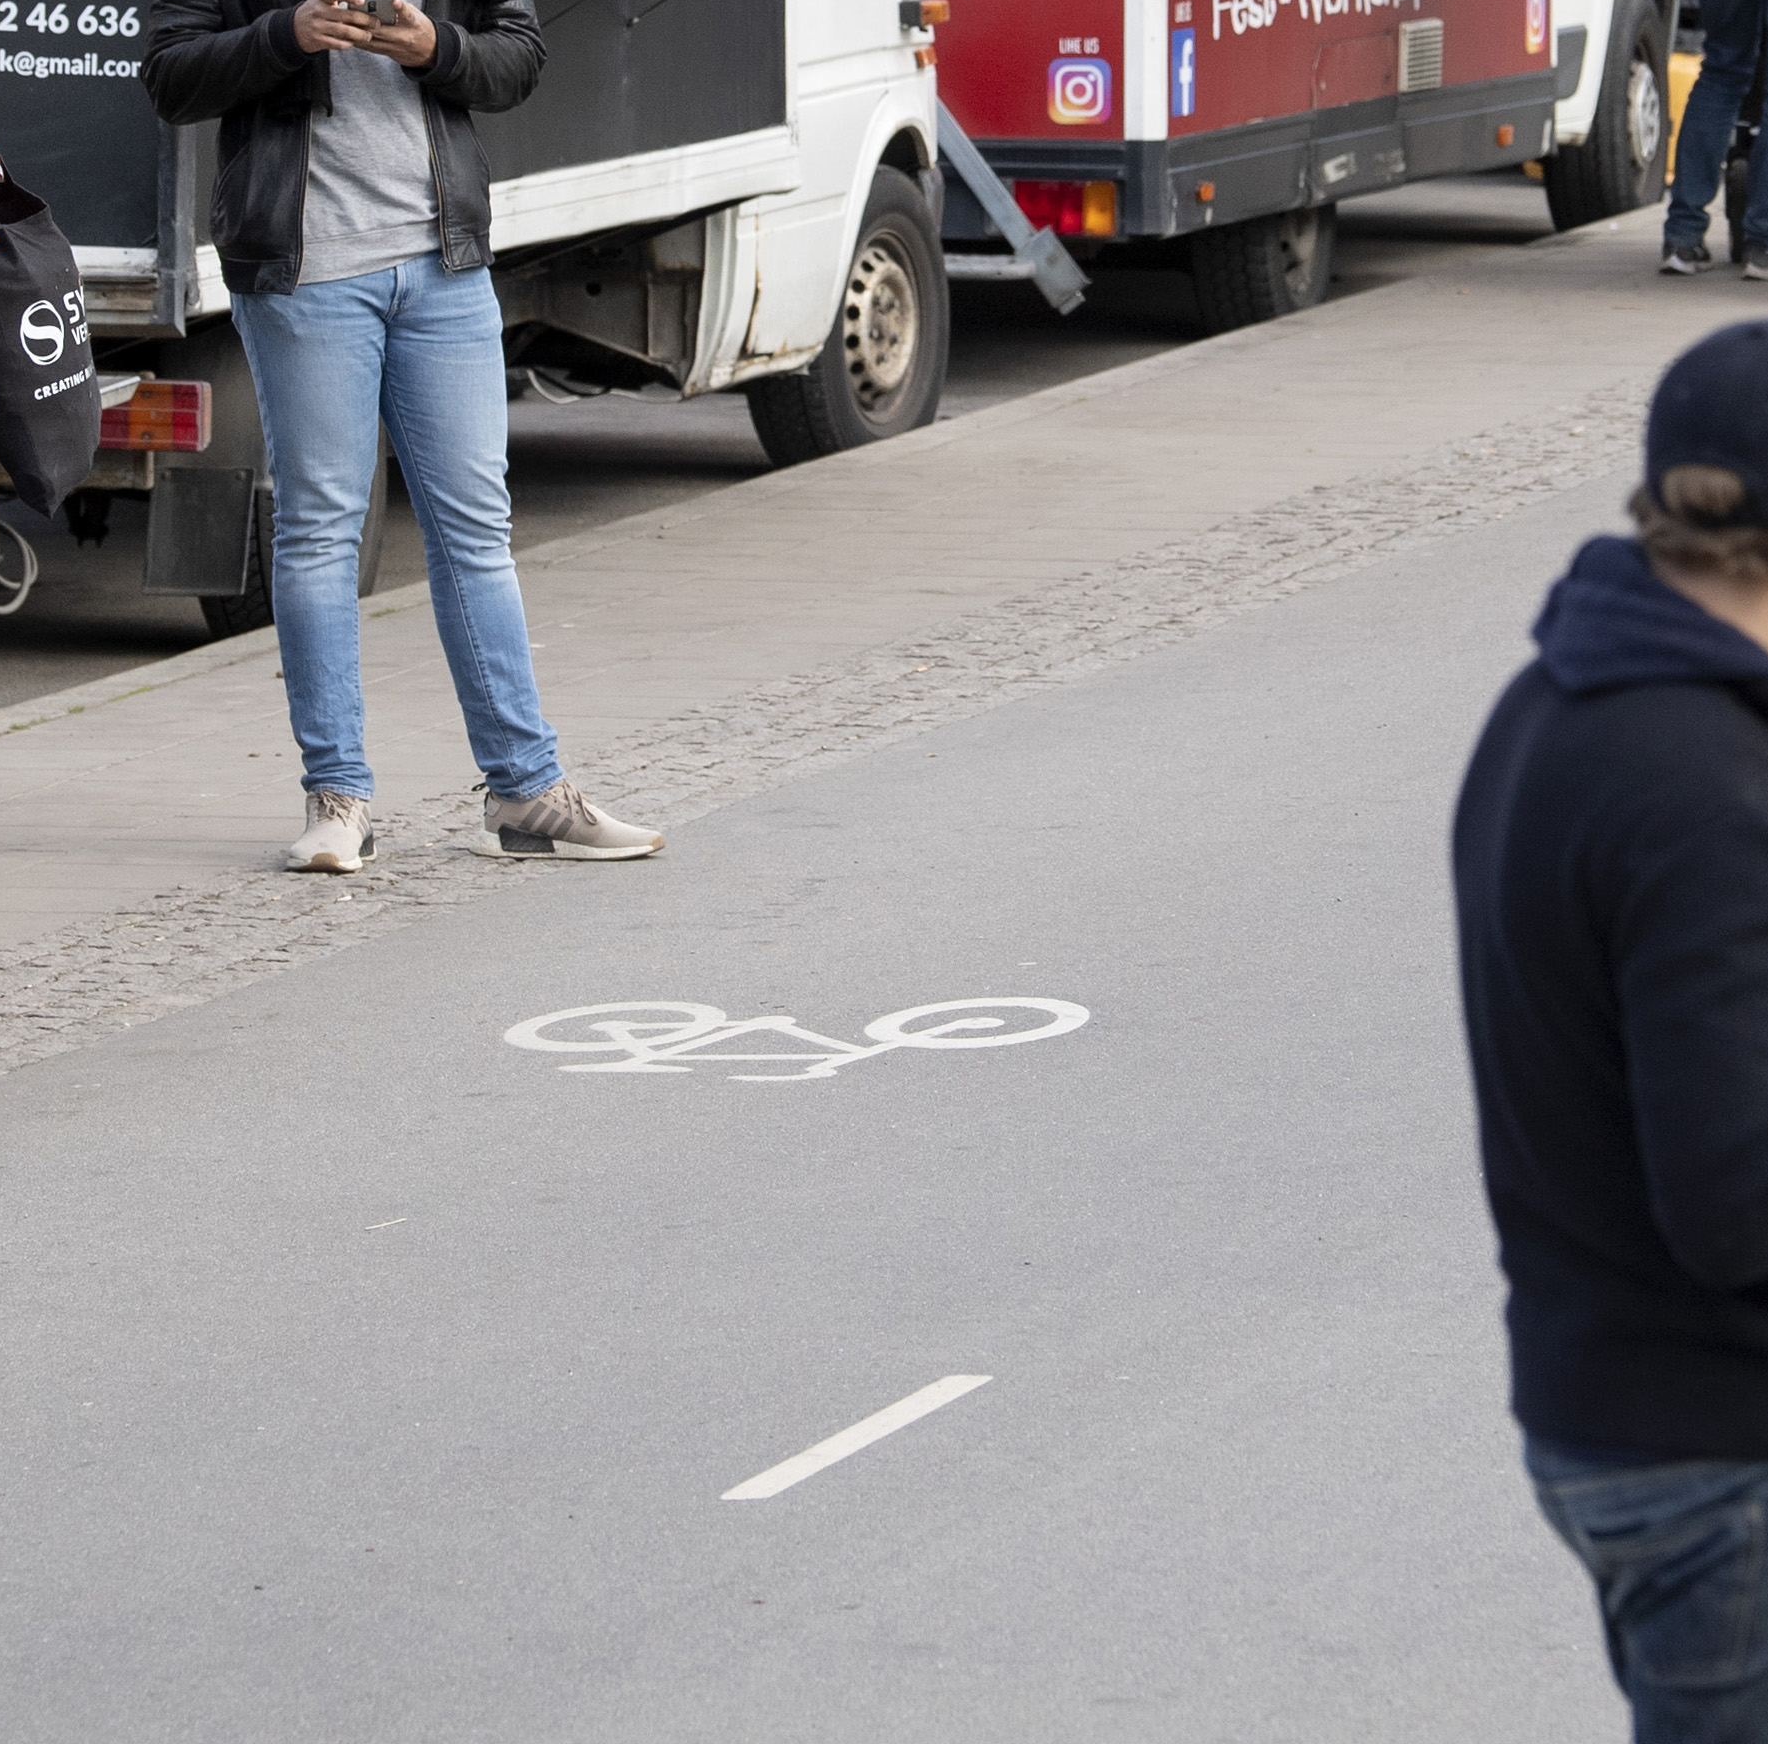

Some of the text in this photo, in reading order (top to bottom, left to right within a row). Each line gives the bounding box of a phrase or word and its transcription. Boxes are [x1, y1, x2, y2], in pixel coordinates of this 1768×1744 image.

[26, 2, 70, 34] 46
[77, 4, 141, 37] 636
[34, 369, 85, 401] CREATING
